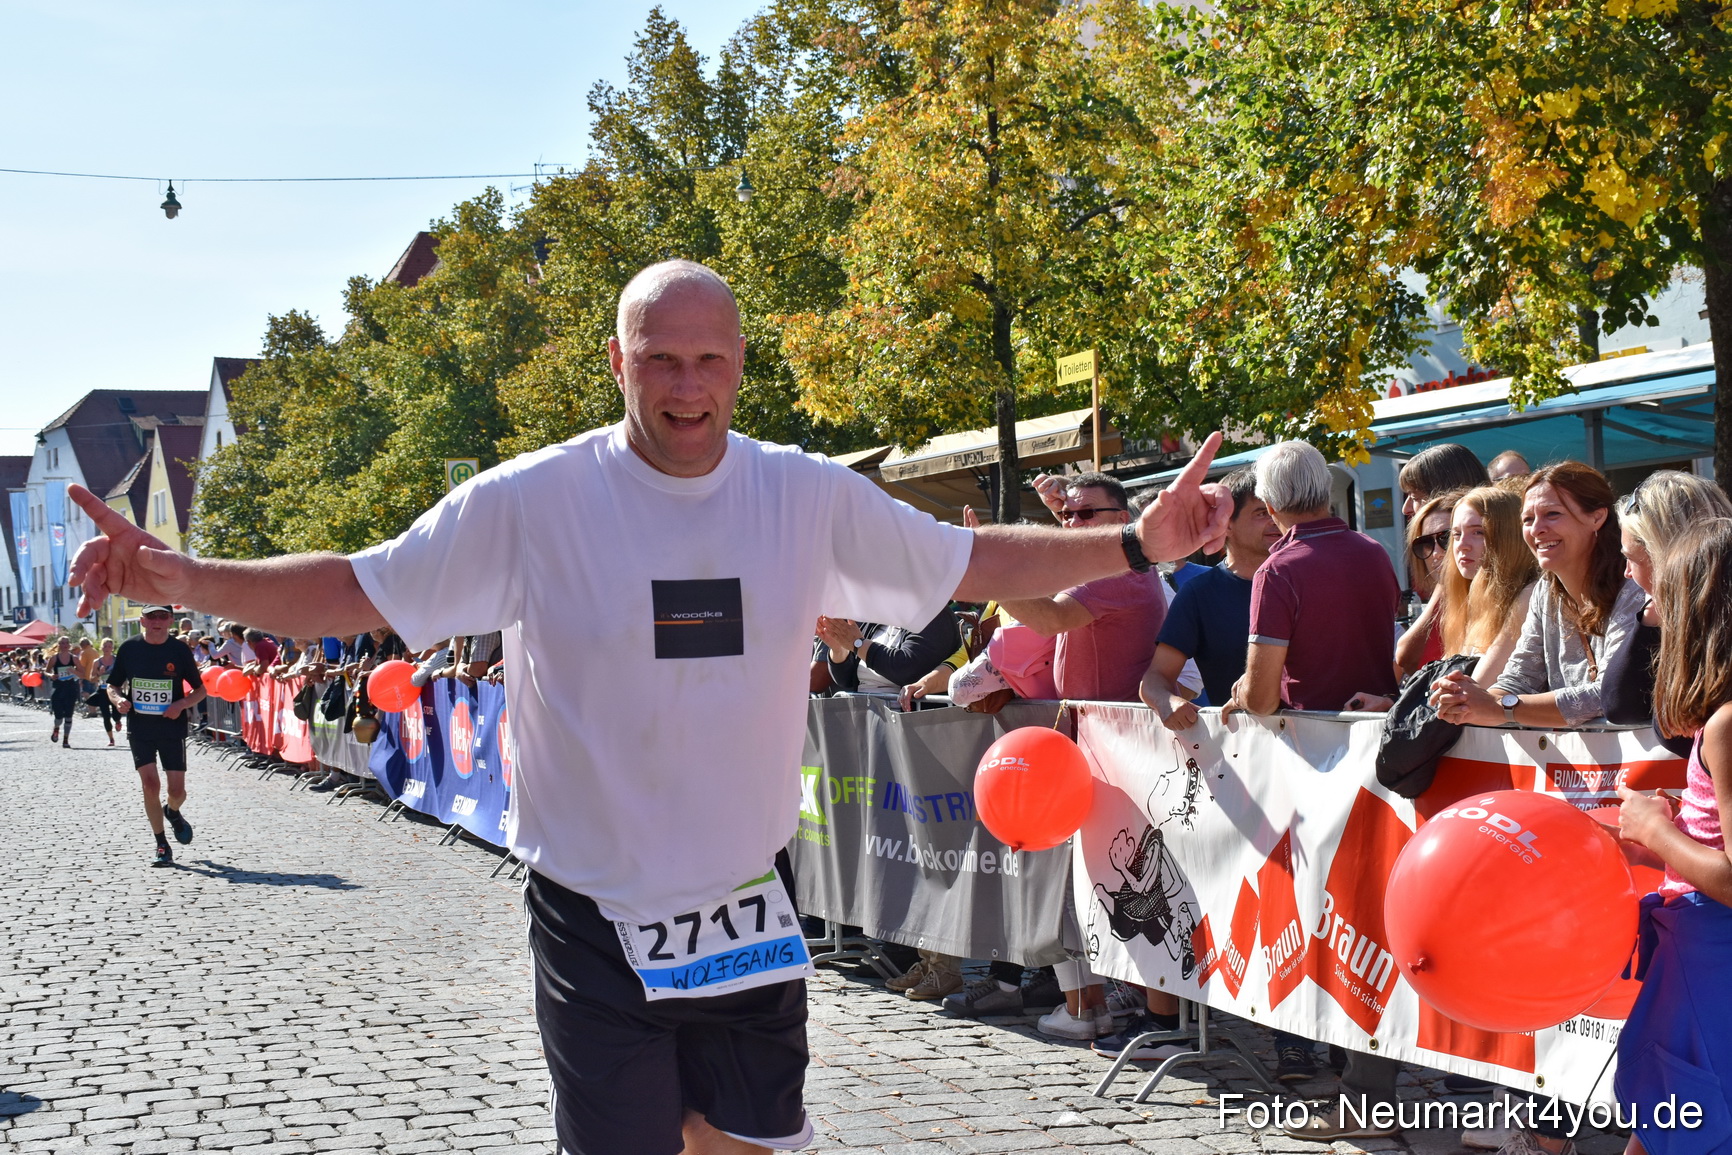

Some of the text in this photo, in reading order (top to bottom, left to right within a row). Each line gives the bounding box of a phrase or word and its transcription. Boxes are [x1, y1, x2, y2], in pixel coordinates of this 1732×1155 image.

[1064, 360, 1092, 376] Toiletten
[457, 468, 469, 481] H
[671, 610, 722, 619] woodka
[135, 680, 168, 689] BOCK
[136, 690, 168, 703] 2619
[1554, 768, 1630, 789] BINDESTRICKE
[1478, 825, 1535, 865] energie
[638, 894, 766, 962] 2717
[1263, 918, 1302, 984] Braun
[1314, 889, 1395, 994] Braun
[671, 943, 794, 990] WOLFGANG
[1334, 963, 1351, 989] Sicher
[1350, 983, 1361, 998] ist
[1579, 1018, 1605, 1041] 09181
